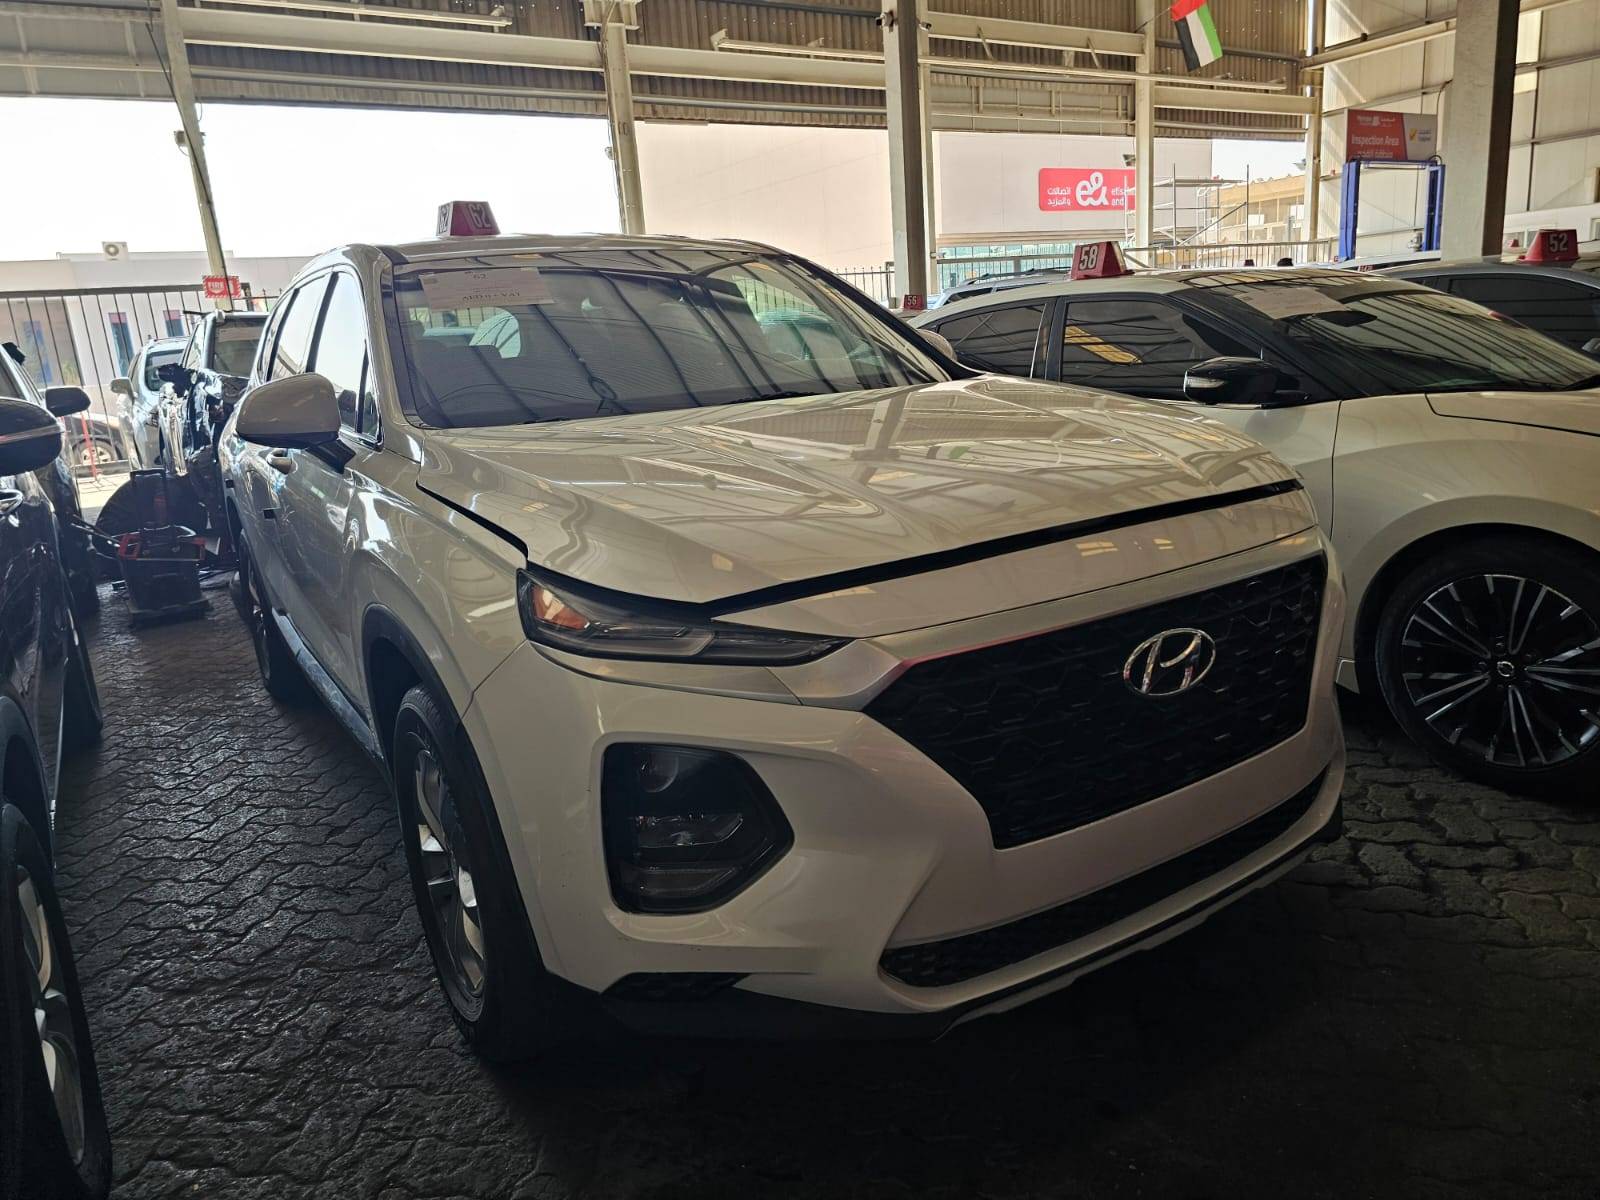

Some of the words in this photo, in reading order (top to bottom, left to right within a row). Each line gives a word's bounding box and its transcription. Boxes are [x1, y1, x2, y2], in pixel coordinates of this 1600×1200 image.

[1351, 135, 1384, 146] Inspection
[1385, 136, 1400, 146] Area
[468, 203, 491, 229] 62
[1549, 233, 1568, 251] 52
[1079, 245, 1099, 270] 58
